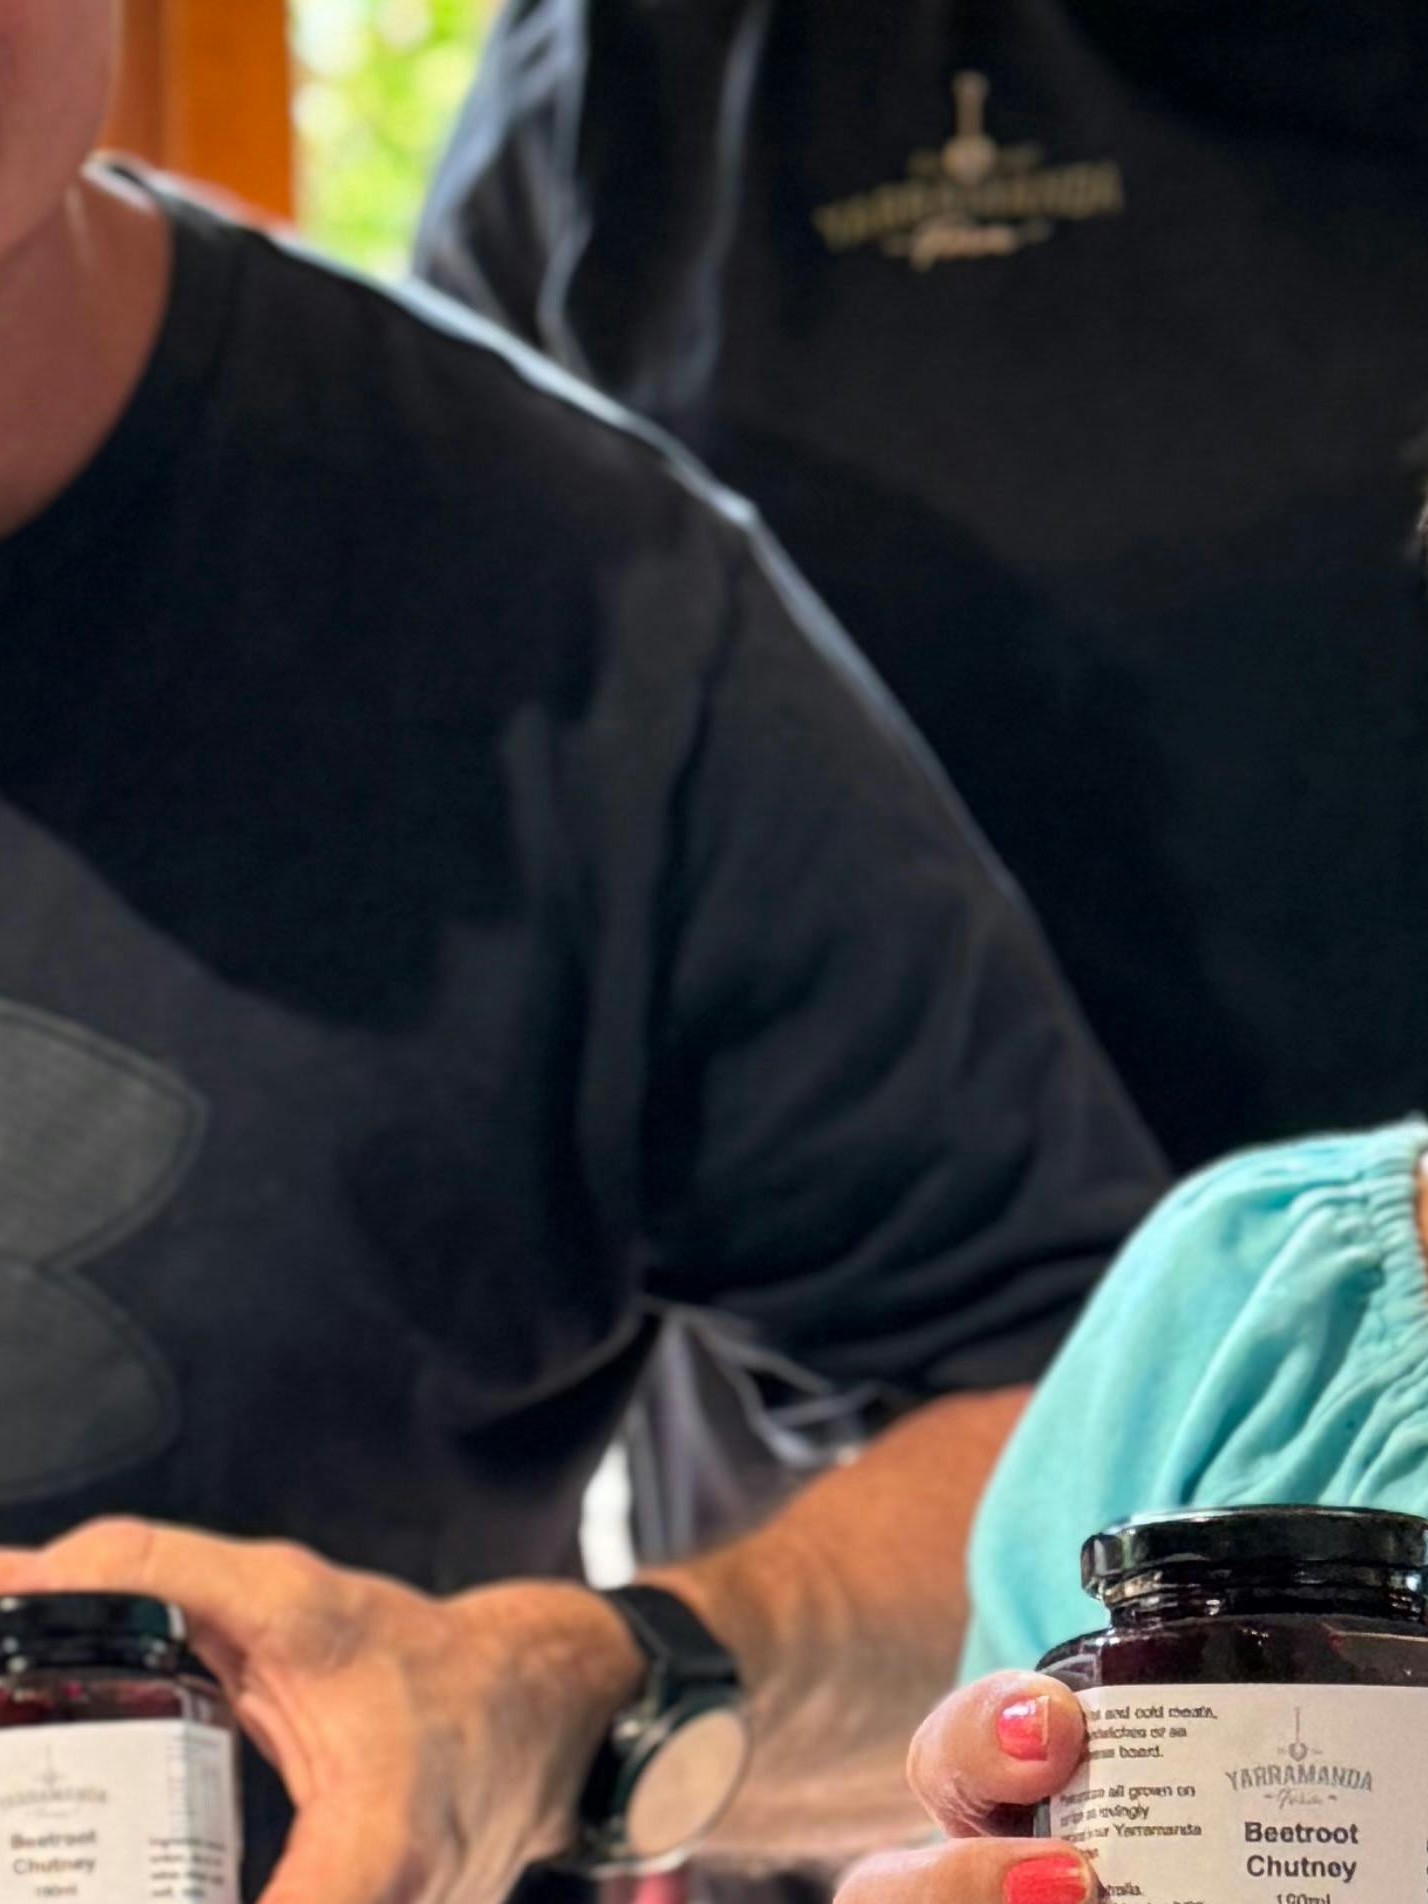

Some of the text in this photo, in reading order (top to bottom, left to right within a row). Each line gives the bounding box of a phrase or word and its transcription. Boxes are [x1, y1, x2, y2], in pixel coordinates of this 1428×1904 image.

[1225, 1764, 1373, 1792] YARRAMANDA
[1244, 1821, 1359, 1844] Beetroot
[12, 1858, 97, 1875] Chutney
[1246, 1855, 1358, 1884] Chutney
